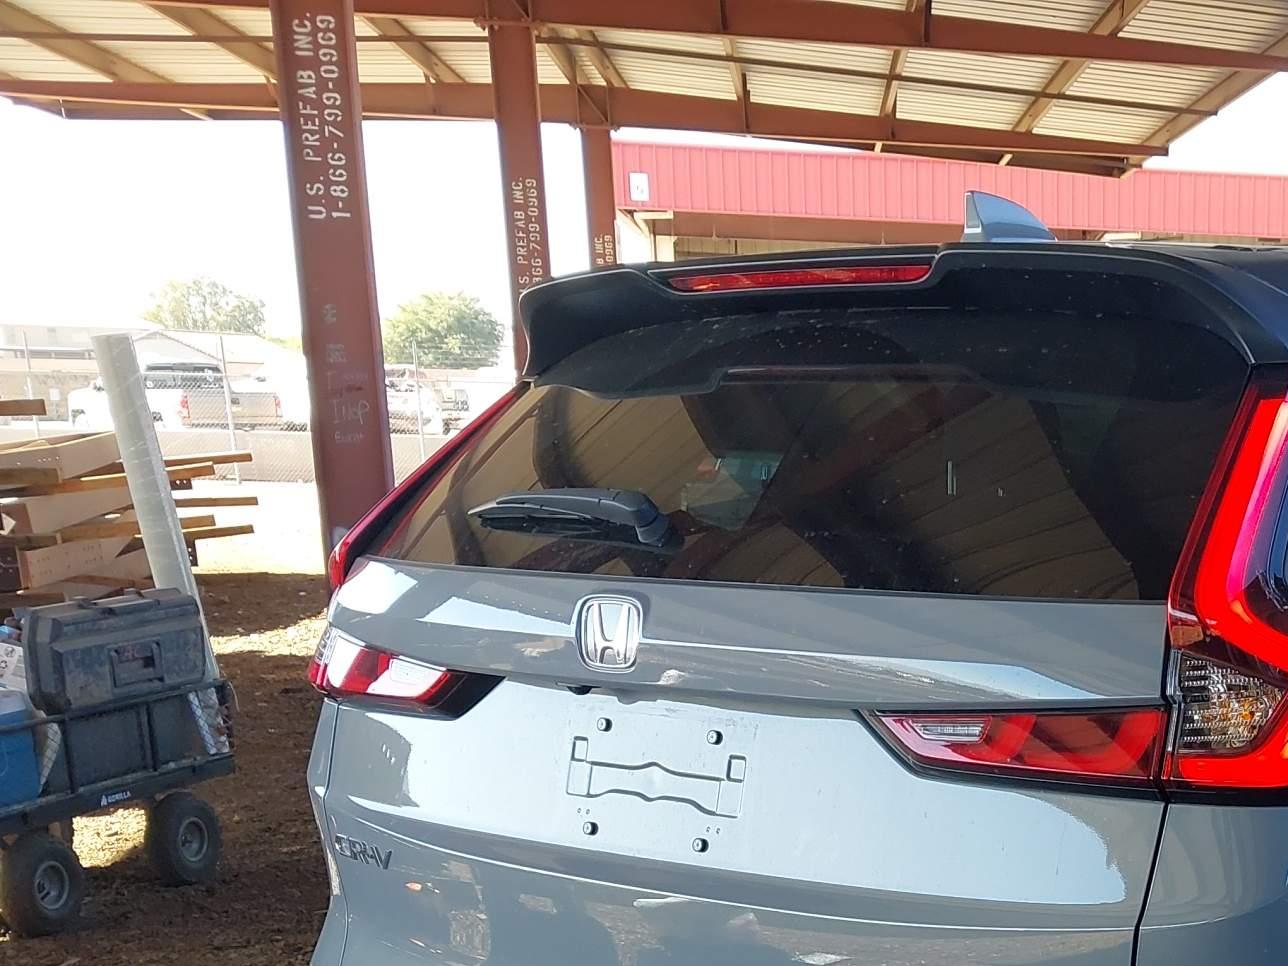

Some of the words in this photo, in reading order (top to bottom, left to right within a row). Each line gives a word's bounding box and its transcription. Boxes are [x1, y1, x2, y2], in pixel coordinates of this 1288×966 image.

[292, 12, 314, 56] INC.
[296, 70, 322, 161] PREFAB
[316, 15, 351, 219] 1-866-799-0969
[306, 176, 327, 220] U.S.
[511, 177, 525, 203] INC.
[513, 210, 529, 264] PREFAB
